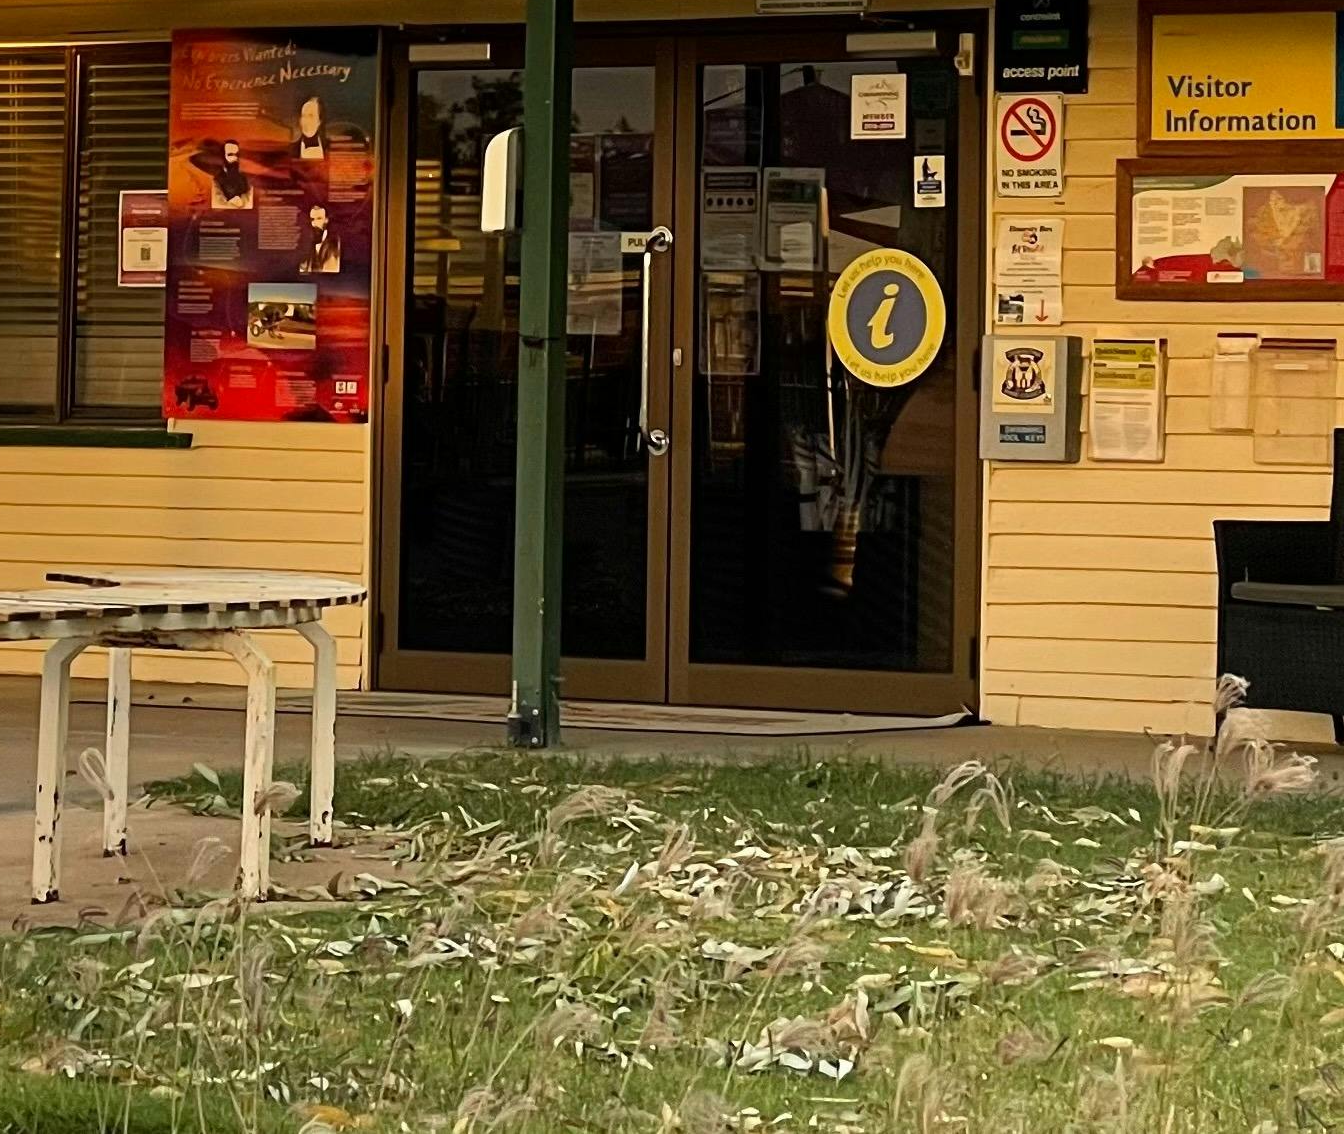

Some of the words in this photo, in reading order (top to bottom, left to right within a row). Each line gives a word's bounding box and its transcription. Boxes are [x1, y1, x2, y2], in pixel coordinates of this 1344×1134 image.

[206, 73, 276, 91] Experience
[279, 61, 351, 83] Necessary
[1003, 67, 1045, 78] access
[1047, 64, 1079, 80] point
[1168, 75, 1252, 98] Visitor
[1166, 108, 1317, 133] Information
[1002, 169, 1014, 177] NO
[1017, 168, 1057, 177] SMOKING
[1001, 181, 1009, 189] IN
[1012, 181, 1030, 189] THIS
[1034, 181, 1058, 189] AREA
[884, 255, 902, 266] you
